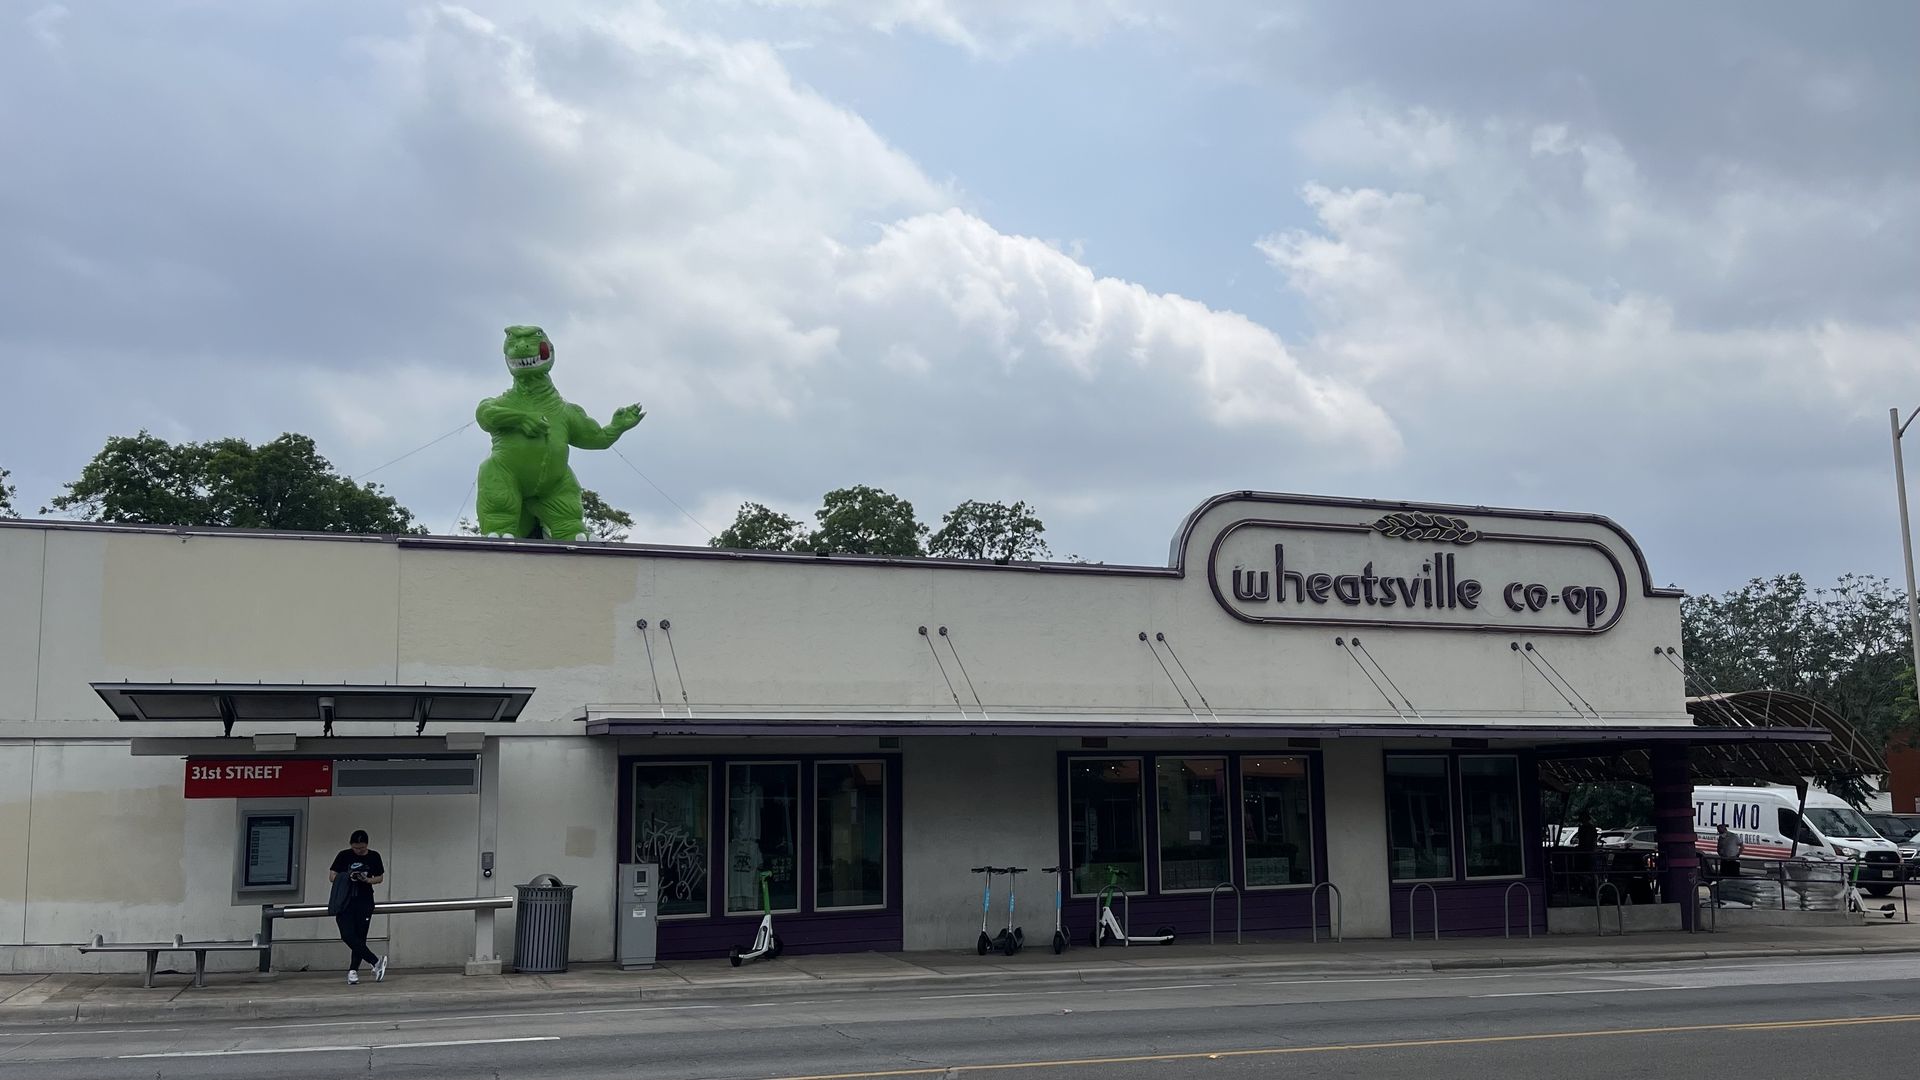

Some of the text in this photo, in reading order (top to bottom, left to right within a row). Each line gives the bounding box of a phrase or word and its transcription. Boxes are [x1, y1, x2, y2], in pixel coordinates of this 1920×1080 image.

[1231, 544, 1609, 627] wheatsville co-op
[191, 766, 283, 779] 31st STREET
